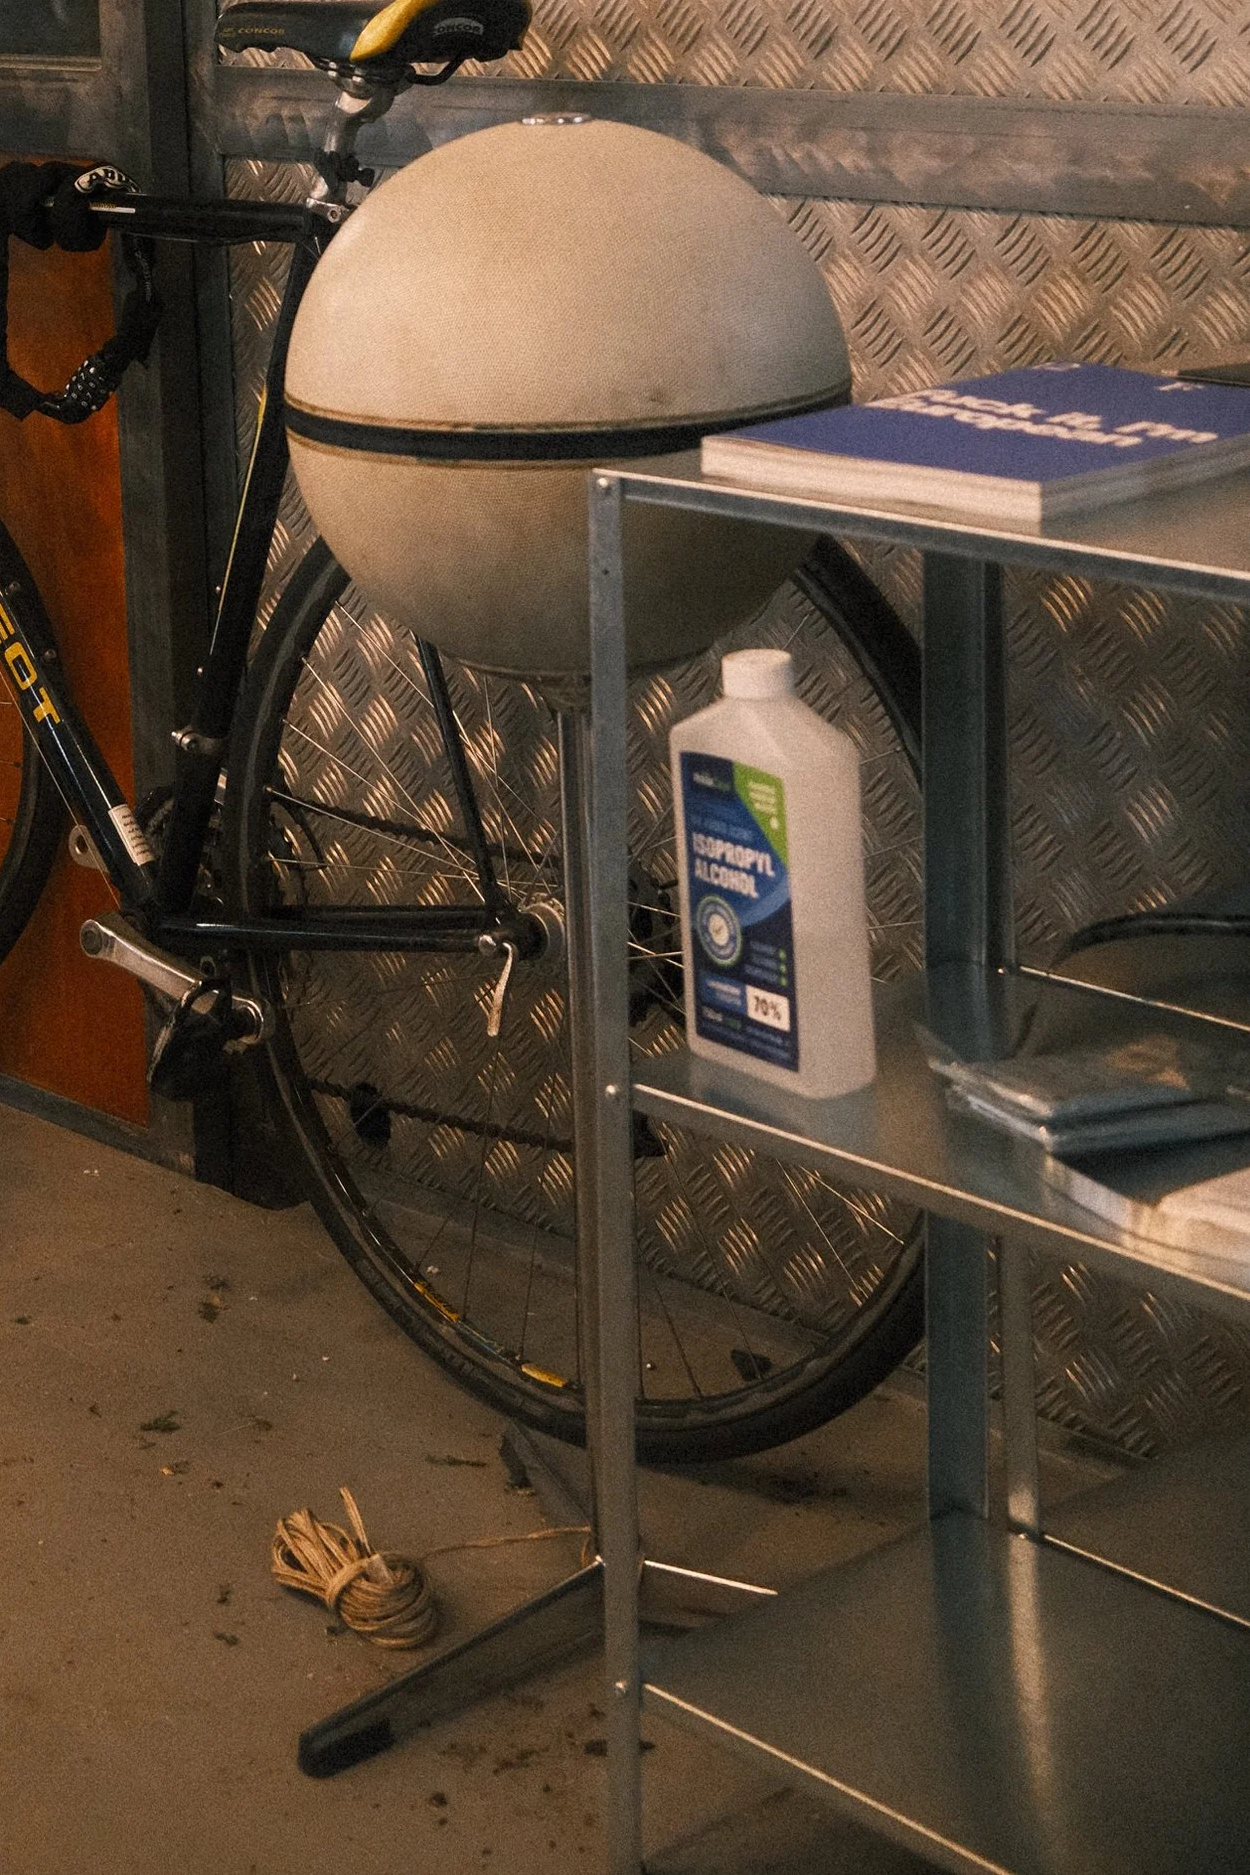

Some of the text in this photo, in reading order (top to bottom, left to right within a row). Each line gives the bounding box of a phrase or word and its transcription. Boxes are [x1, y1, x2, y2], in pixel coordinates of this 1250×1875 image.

[692, 831, 776, 878] ISOPROPYL
[694, 857, 760, 899] ALCOHOL
[752, 994, 783, 1023] 70%
